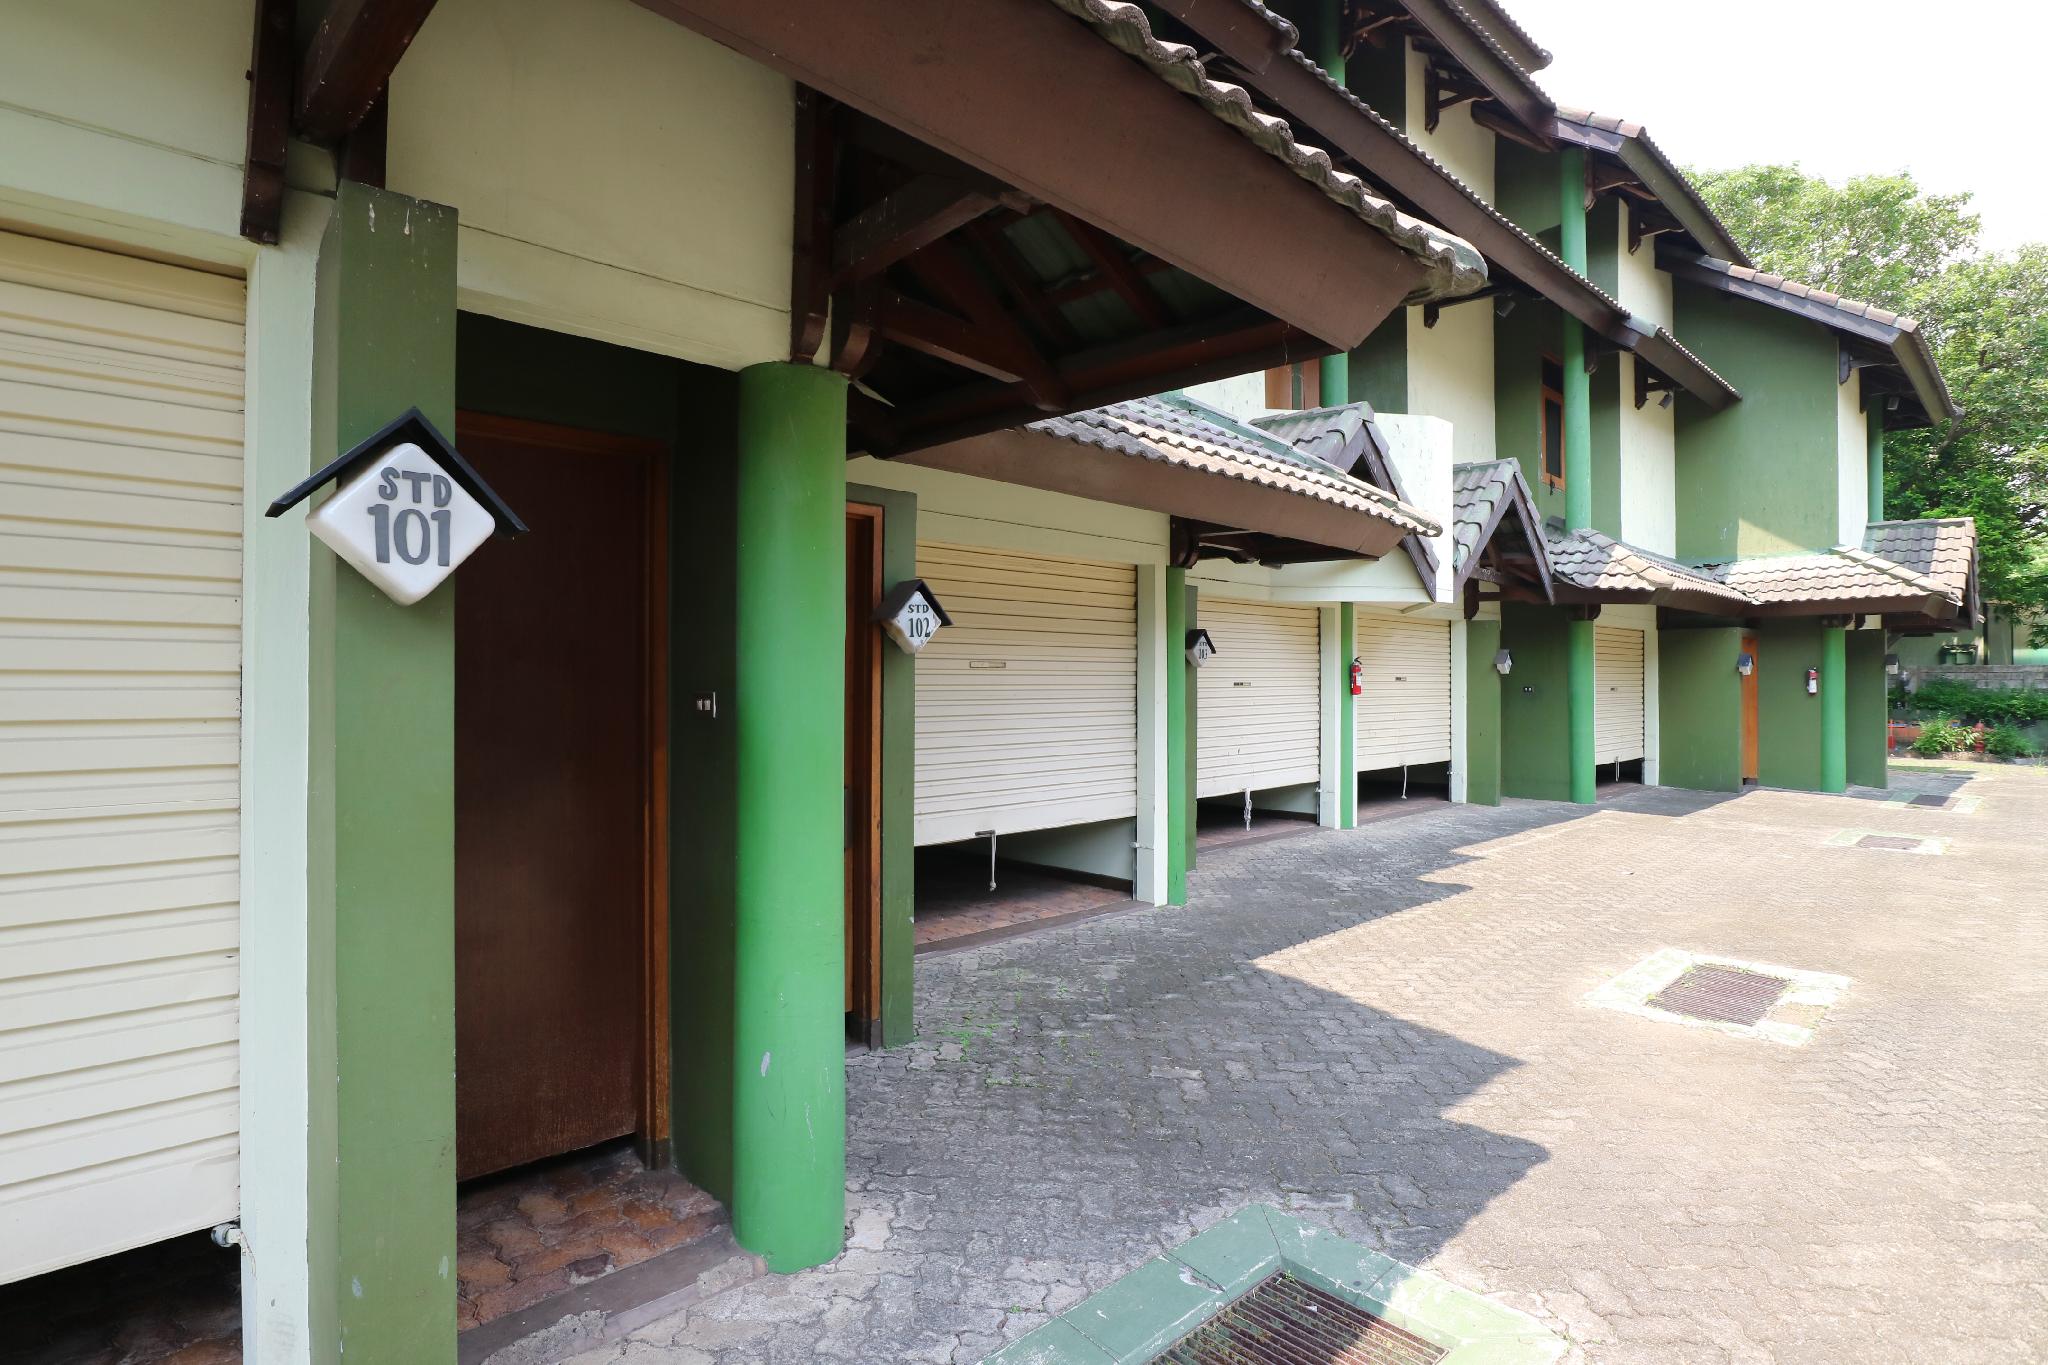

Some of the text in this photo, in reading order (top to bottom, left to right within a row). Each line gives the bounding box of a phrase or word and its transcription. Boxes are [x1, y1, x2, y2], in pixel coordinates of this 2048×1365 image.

[378, 466, 452, 507] STD
[367, 503, 451, 567] 101
[908, 604, 930, 613] STD
[908, 617, 931, 637] 102
